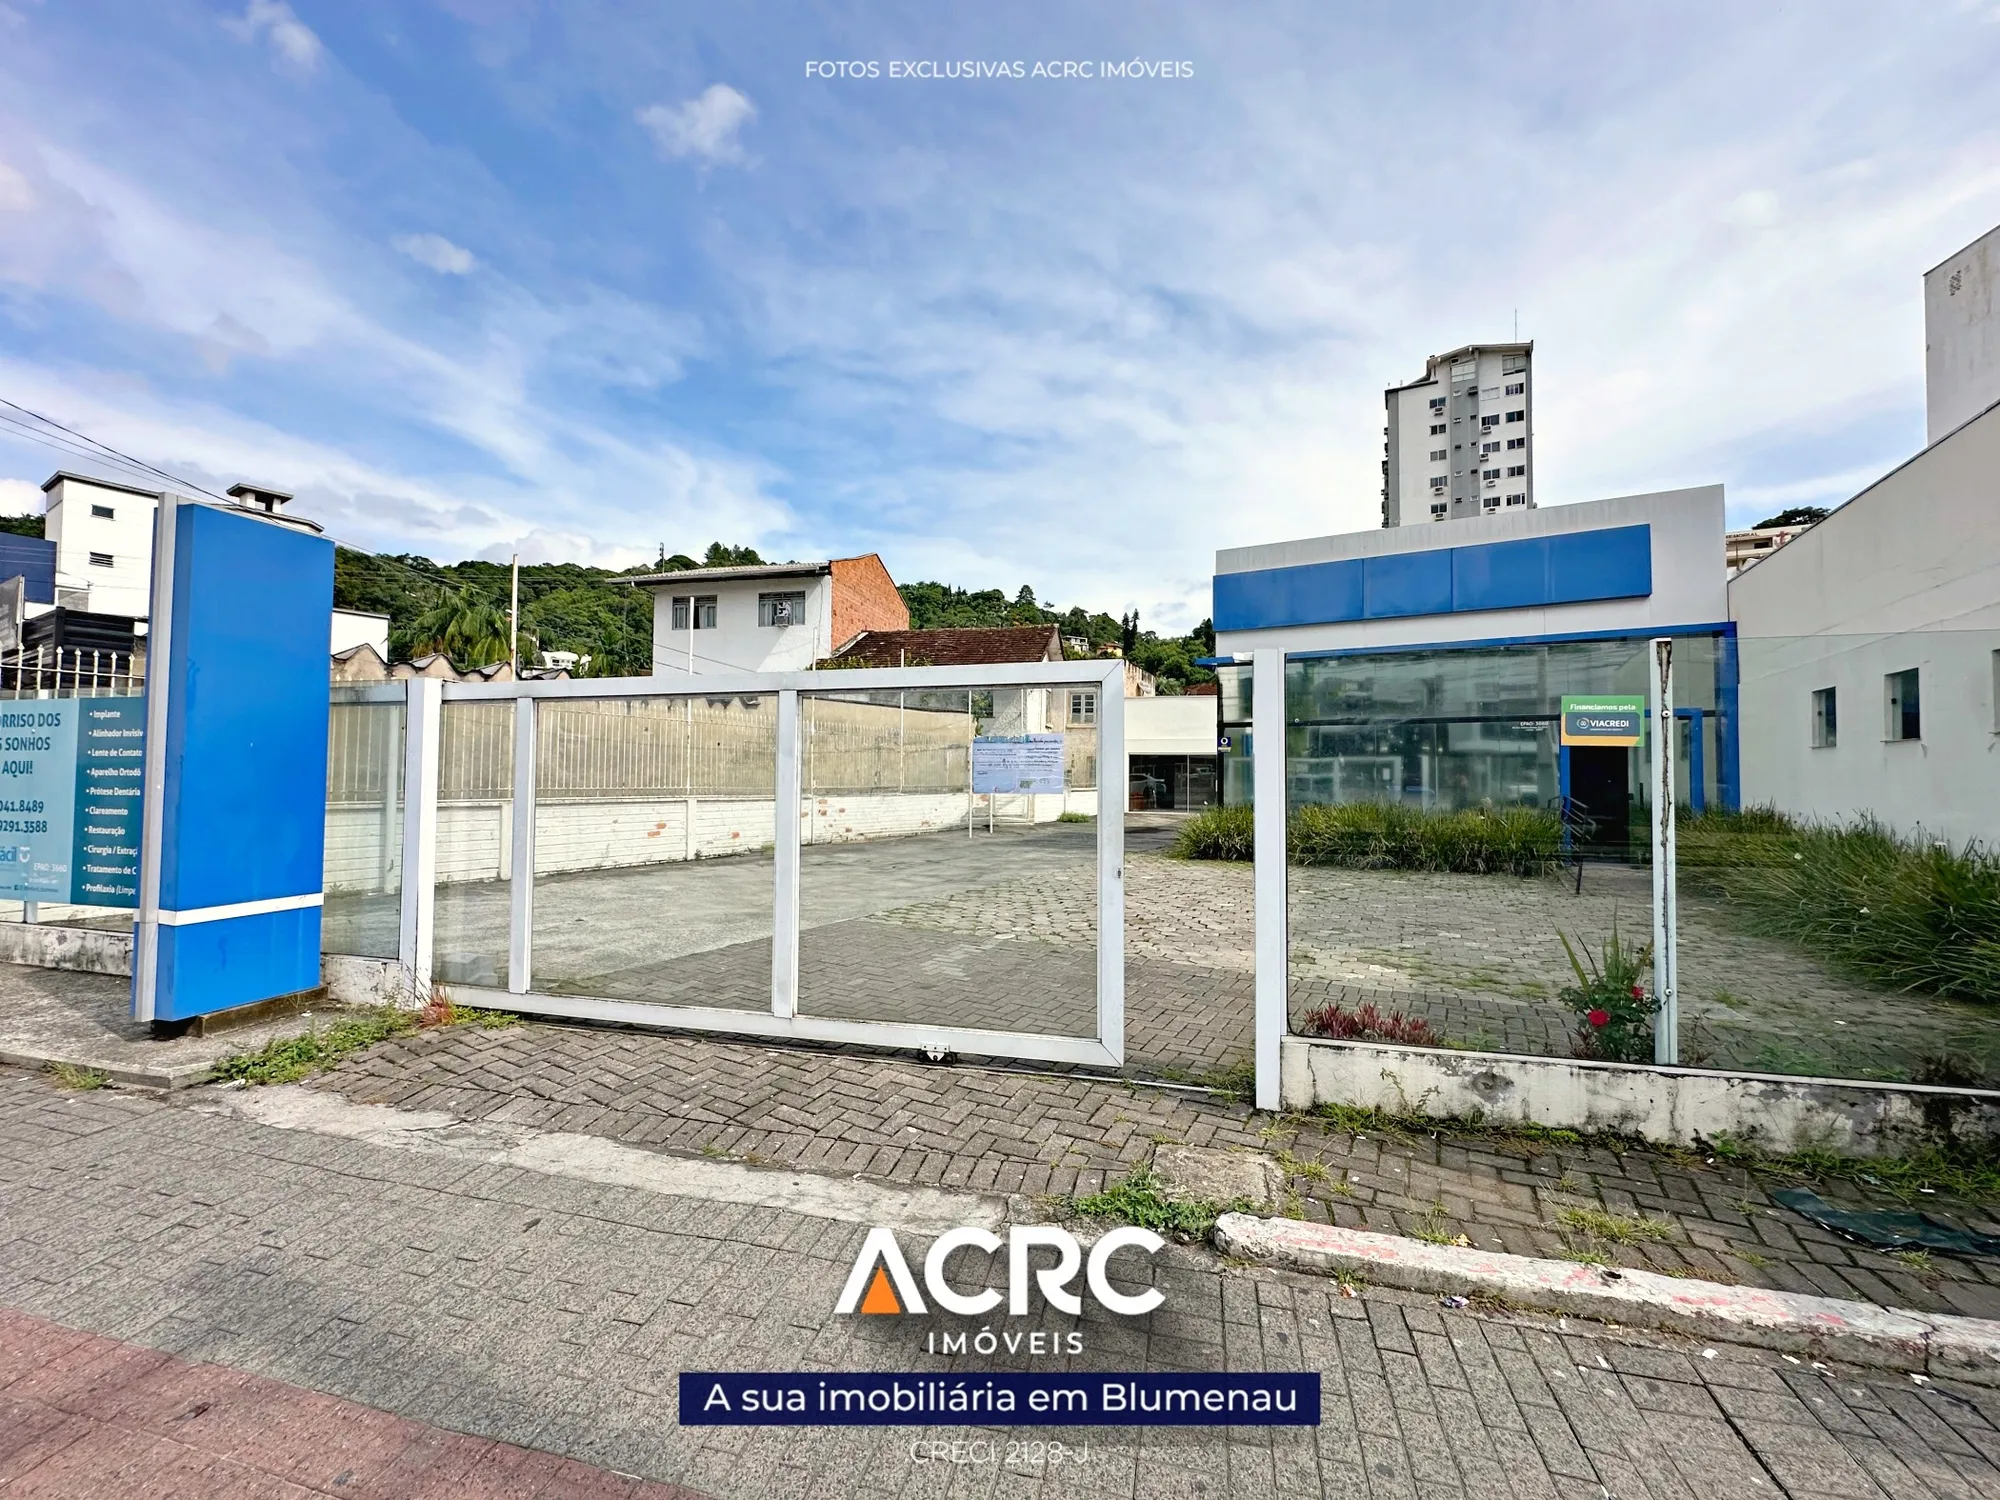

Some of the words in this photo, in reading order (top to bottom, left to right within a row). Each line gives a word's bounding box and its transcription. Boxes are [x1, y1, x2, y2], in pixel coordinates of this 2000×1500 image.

[1618, 704, 1636, 712] pela
[37, 712, 61, 727] DOS
[93, 710, 121, 720] Implante
[1590, 719, 1629, 728] VIACREDI
[92, 729, 122, 738] Alinhador
[5, 736, 51, 751] SONHOS
[91, 748, 109, 757] Lente
[110, 749, 118, 757] de
[118, 748, 142, 757] Contato
[2, 760, 33, 778] AQUI!
[90, 767, 118, 778] Aparelho
[90, 786, 113, 796] Prótese
[114, 787, 141, 796] Dentária
[89, 806, 128, 815] Clareamento
[88, 825, 125, 837] Restauração
[87, 845, 112, 856] Cirurgia
[87, 864, 122, 875] Tratamento
[123, 866, 131, 875] de
[85, 883, 115, 894] Profilaxia
